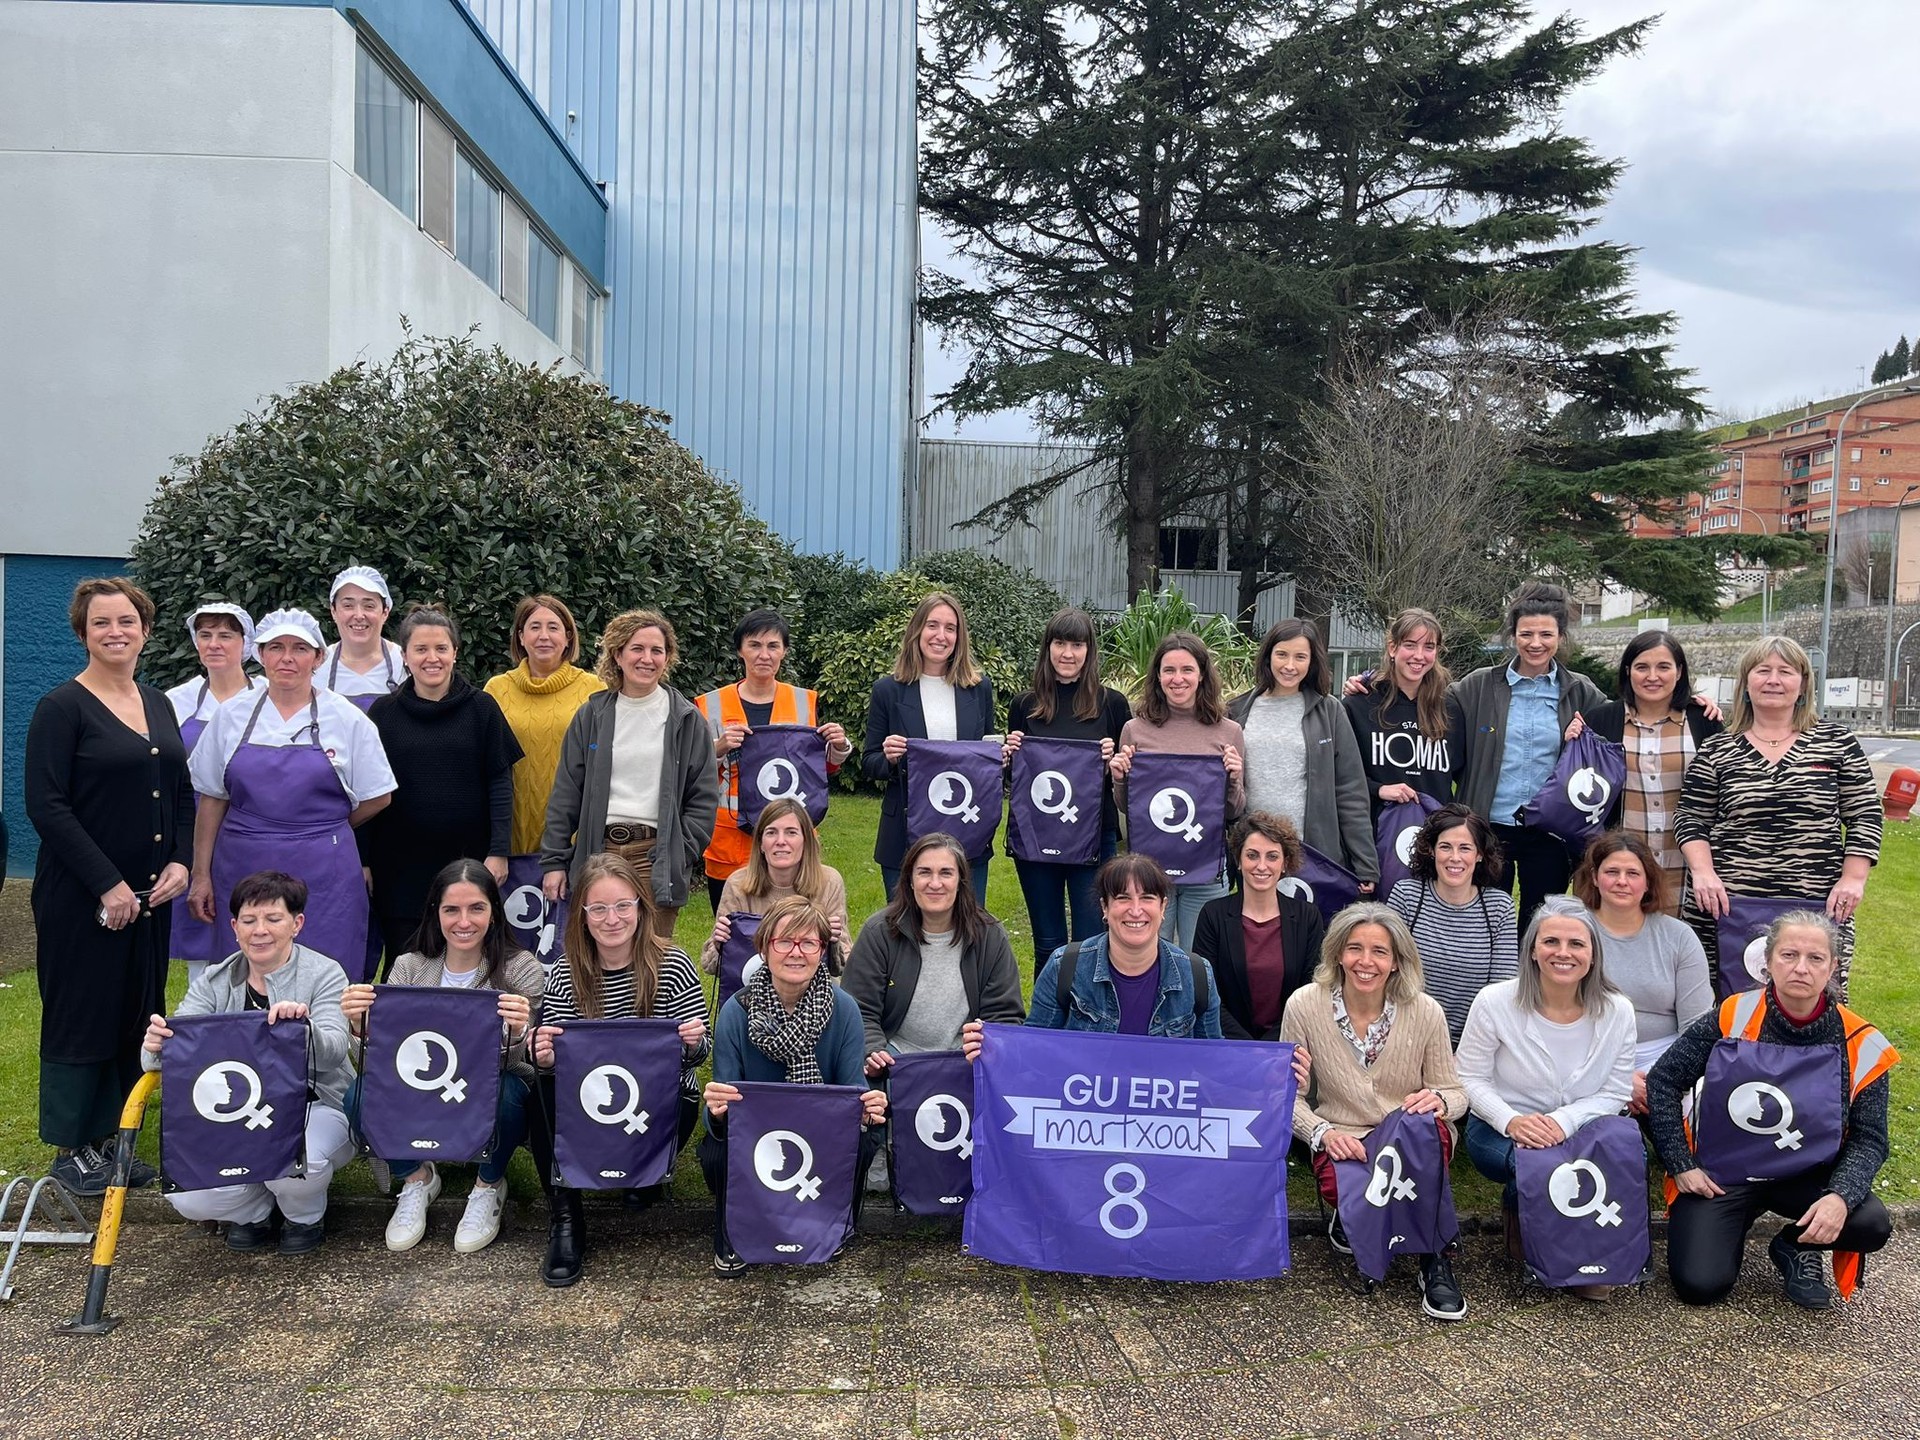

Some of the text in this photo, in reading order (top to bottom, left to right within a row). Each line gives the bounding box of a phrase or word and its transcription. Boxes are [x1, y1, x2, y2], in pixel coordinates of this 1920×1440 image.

[1401, 721, 1420, 730] STA
[1371, 731, 1450, 773] HOMAS
[1063, 1073, 1200, 1111] GU ERE
[1045, 1118, 1216, 1153] martxoak
[1099, 1162, 1148, 1239] 8
